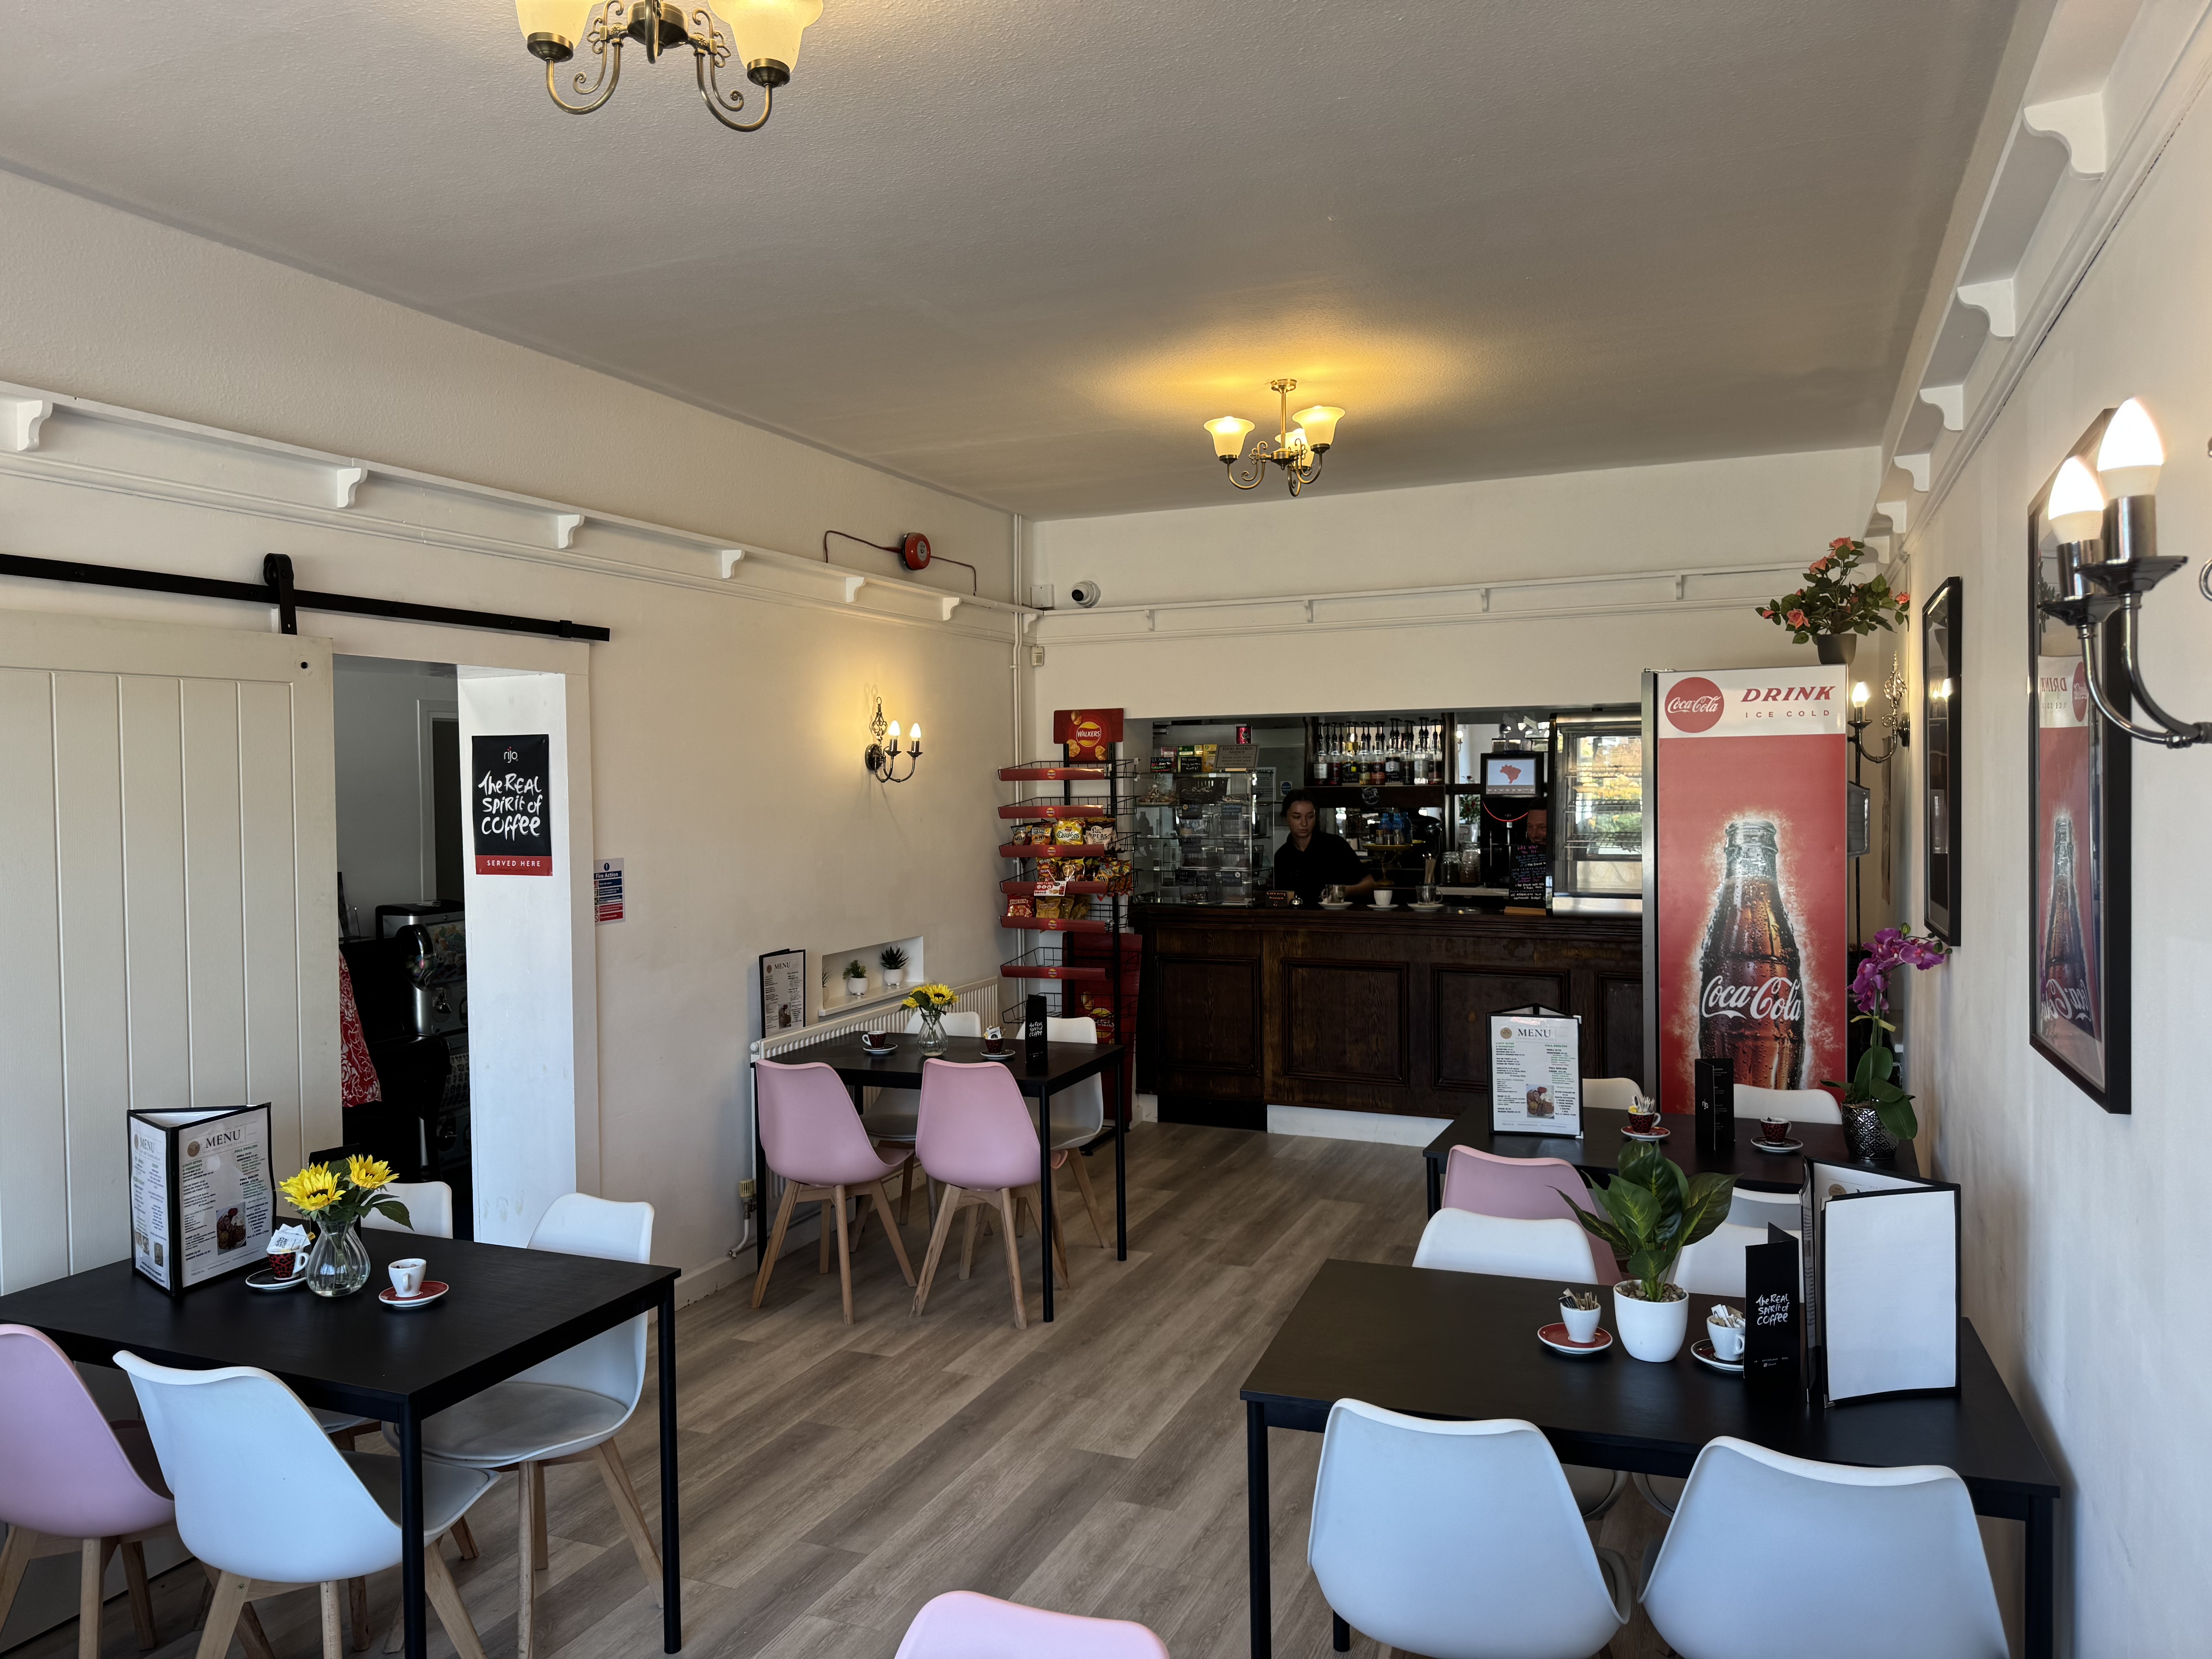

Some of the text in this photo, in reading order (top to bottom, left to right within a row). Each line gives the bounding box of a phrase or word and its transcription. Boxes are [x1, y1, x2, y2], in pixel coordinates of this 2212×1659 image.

[1741, 686, 1836, 702] DRINK
[1668, 696, 1721, 713] Coca-Cola
[478, 771, 542, 796] The REAL
[527, 794, 543, 816] of
[1702, 975, 1802, 1021] Coca-Cola
[1518, 1029, 1551, 1037] MENU
[140, 1137, 155, 1153] MENU
[205, 1130, 240, 1148] MENU
[1755, 1293, 1789, 1306] The REAL
[1782, 1302, 1790, 1312] of
